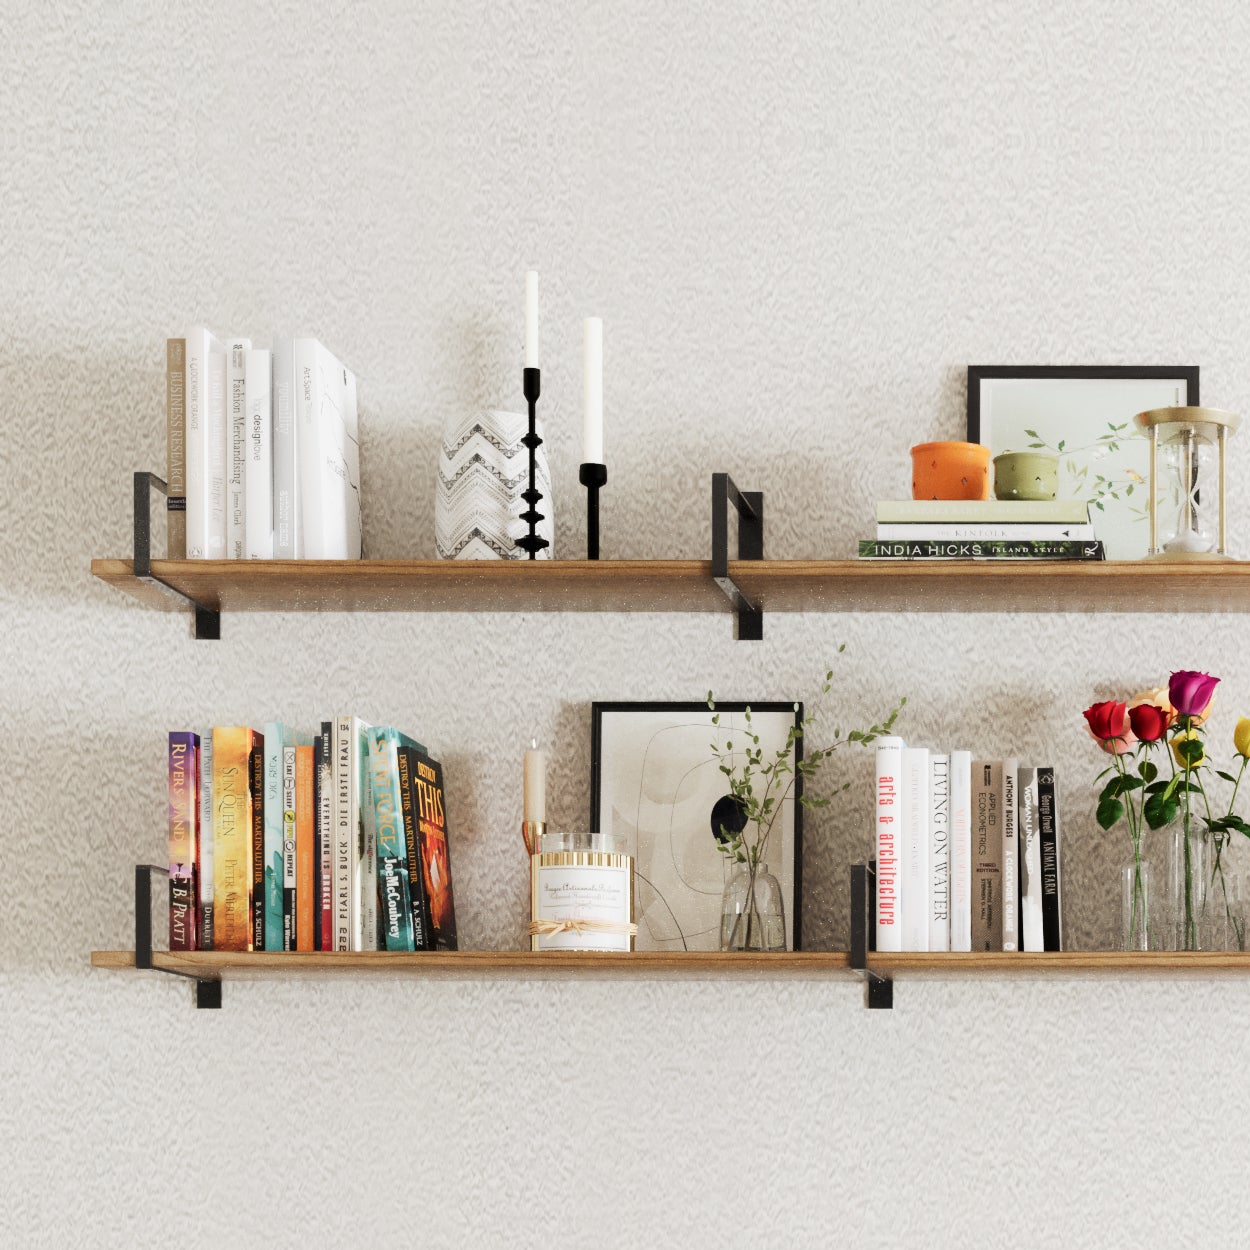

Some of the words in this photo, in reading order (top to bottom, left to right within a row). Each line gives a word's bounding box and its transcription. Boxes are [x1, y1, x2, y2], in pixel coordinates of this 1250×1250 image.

[171, 372, 182, 426] BUSINESS
[233, 379, 245, 413] Fashion
[171, 431, 183, 492] RESEARCH
[230, 417, 245, 484] Merchandising
[874, 545, 922, 555] INDIA
[929, 544, 982, 555] HICKS
[172, 744, 186, 794] RIVERS
[340, 739, 349, 767] FRAU
[372, 740, 390, 787] SPENT
[222, 767, 238, 792] SUN
[399, 754, 409, 789] DESTROY
[340, 773, 348, 804] ERSTE
[402, 793, 411, 811] THIS
[415, 777, 444, 827] THIS
[879, 777, 896, 805] arts
[934, 761, 947, 824] LIVING
[339, 809, 348, 827] DIE
[377, 793, 395, 844] FORCE
[404, 816, 415, 851] MARTIN
[339, 841, 348, 870] BUCK
[934, 831, 947, 855] ON
[1043, 842, 1054, 872] ANIMAL
[323, 860, 330, 869] IS
[407, 851, 417, 883] LUTHER
[879, 834, 898, 925] architecture
[174, 889, 187, 899] B.
[934, 862, 947, 921] WATER
[1044, 875, 1055, 895] FARM
[339, 886, 348, 919] PEARL
[173, 902, 187, 945] PRATT
[414, 917, 423, 945] SCHULZ
